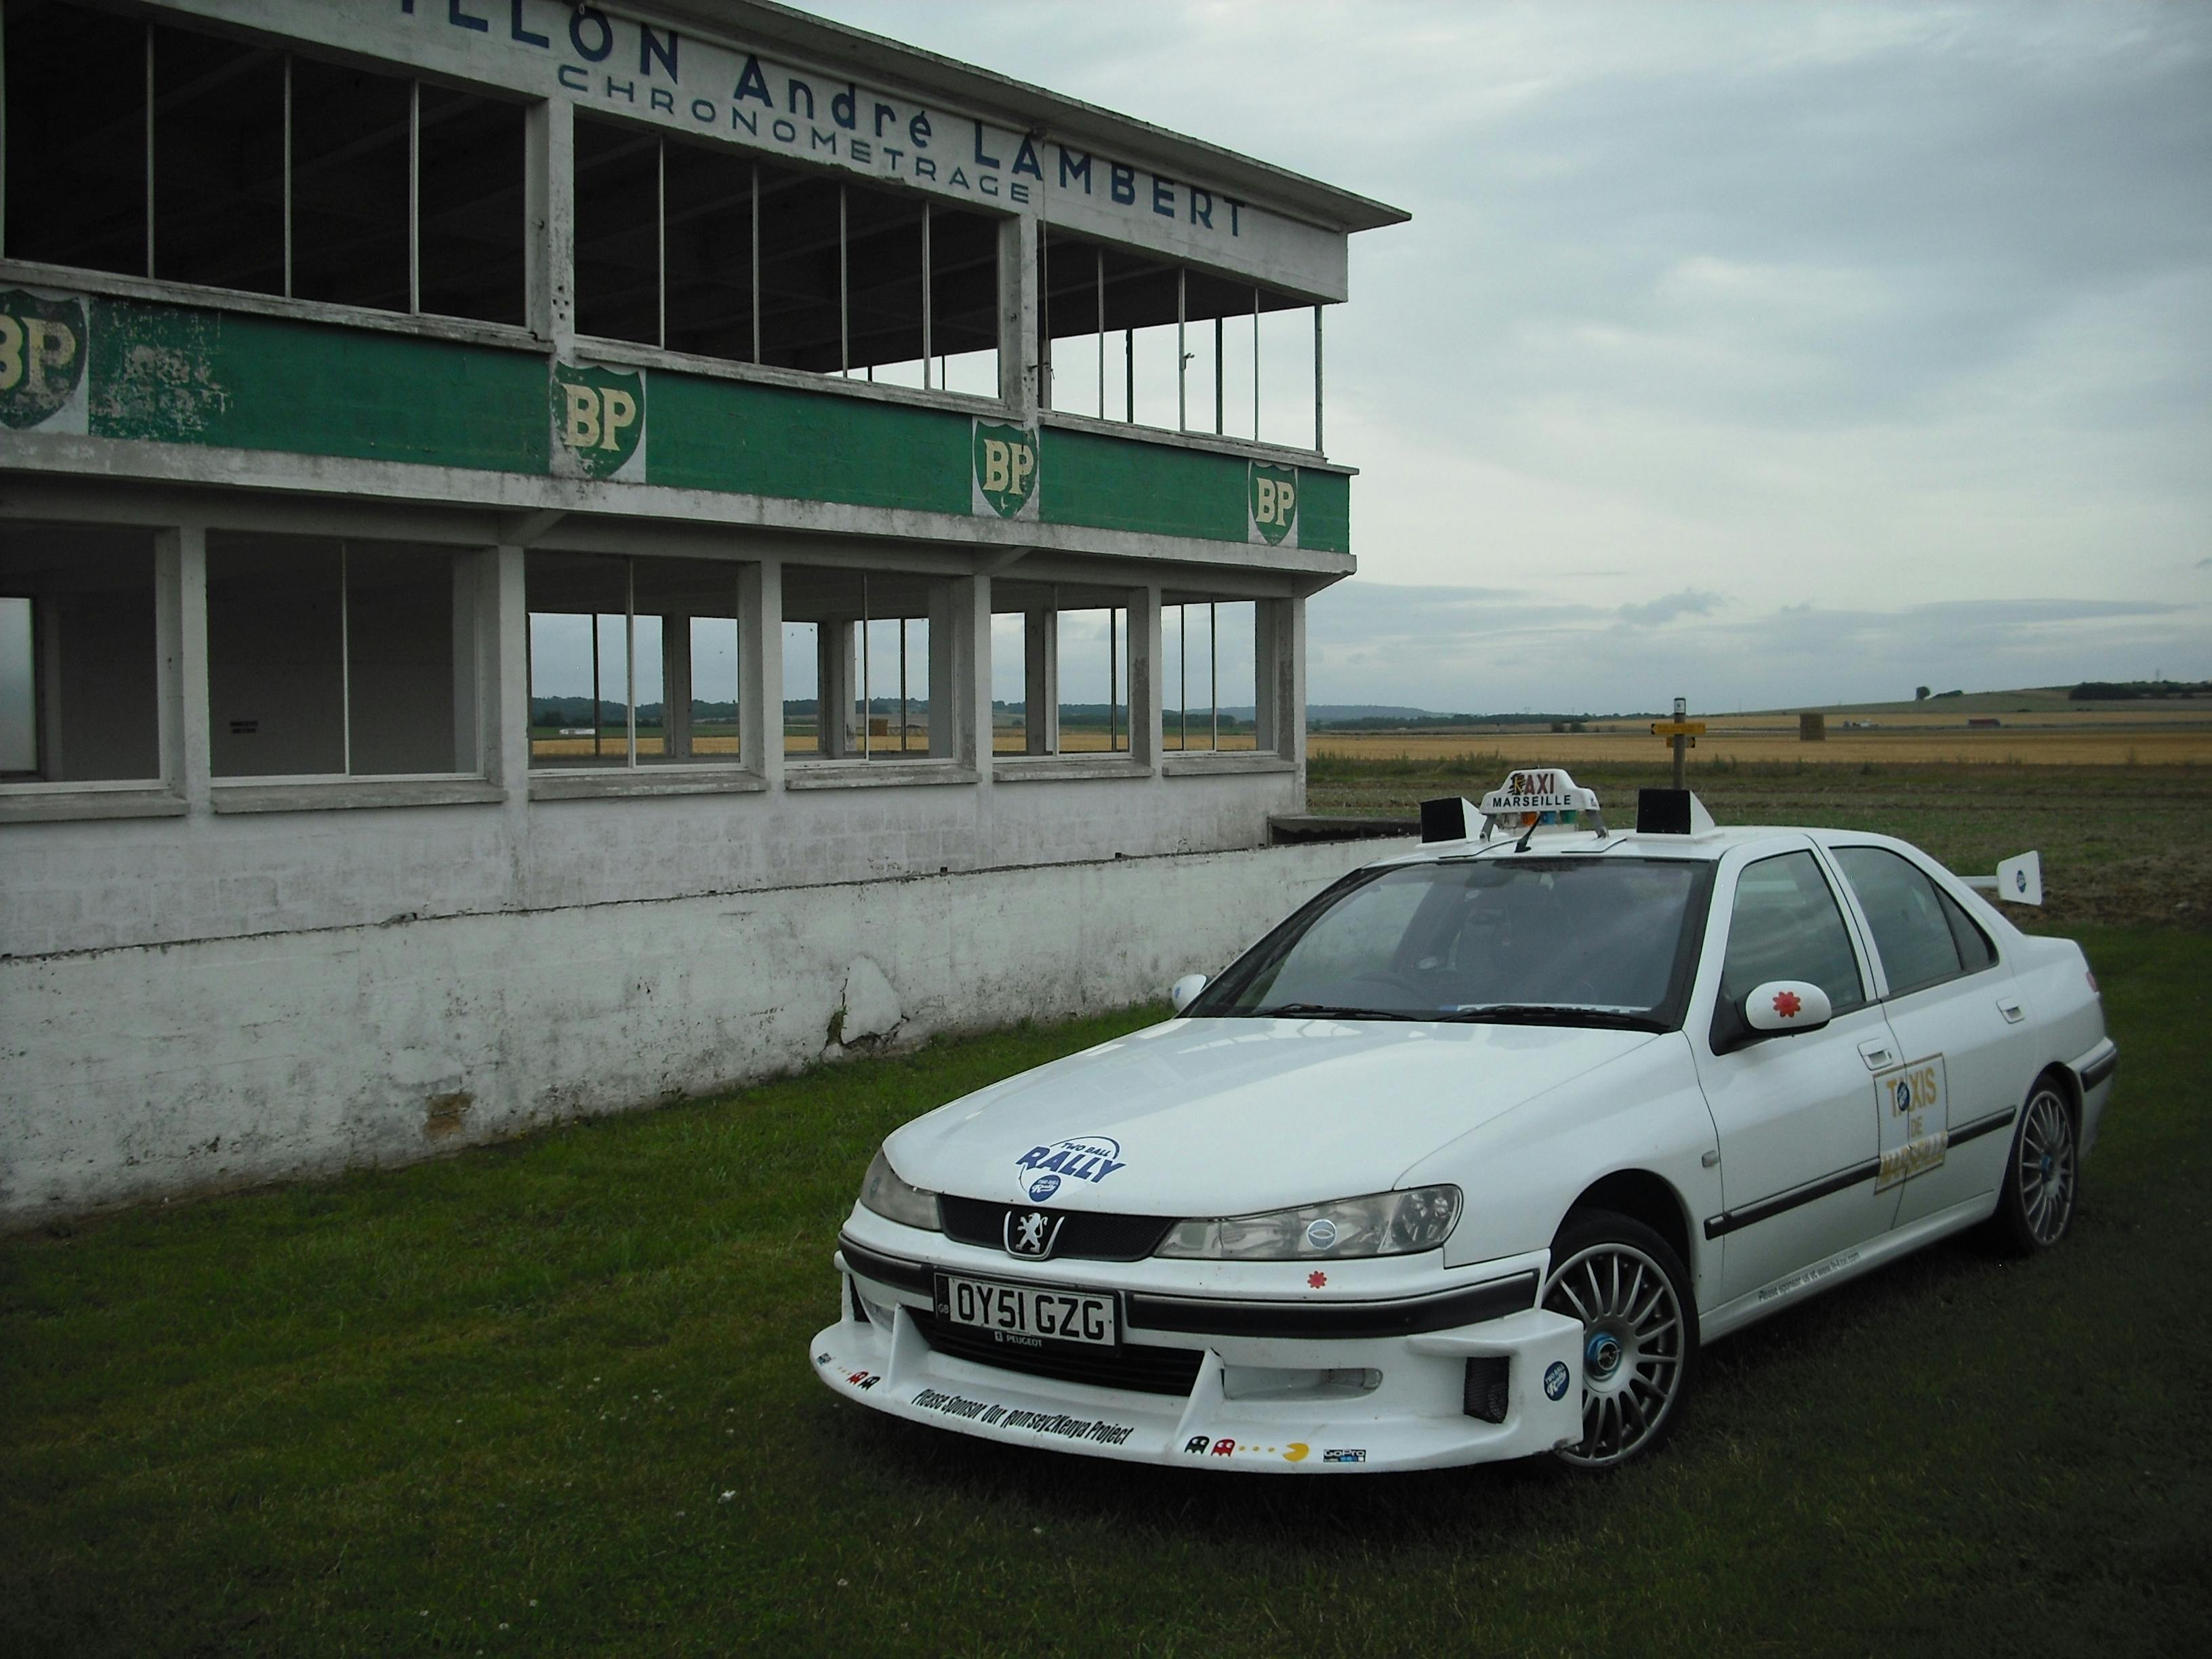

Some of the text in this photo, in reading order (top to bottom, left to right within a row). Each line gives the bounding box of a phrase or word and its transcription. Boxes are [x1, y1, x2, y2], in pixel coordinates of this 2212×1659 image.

[401, 0, 1246, 237] LLON André LAMBERT
[558, 64, 1029, 205] CHRONOMETRAGE
[561, 384, 636, 451] BP
[983, 438, 1034, 495] BP
[1256, 477, 1295, 527] BP
[1492, 795, 1572, 807] MARSEILLE
[1015, 1146, 1126, 1183] RALLY
[1061, 1143, 1111, 1157] TWO BALL
[938, 1304, 949, 1314] GB
[957, 1283, 1105, 1341] OY51 GZG
[1006, 1334, 1042, 1347] PEUGEOT
[911, 1389, 948, 1410] Please
[941, 1395, 987, 1420] Sponsor
[981, 1404, 1008, 1425] Our
[1084, 1420, 1134, 1446] Project
